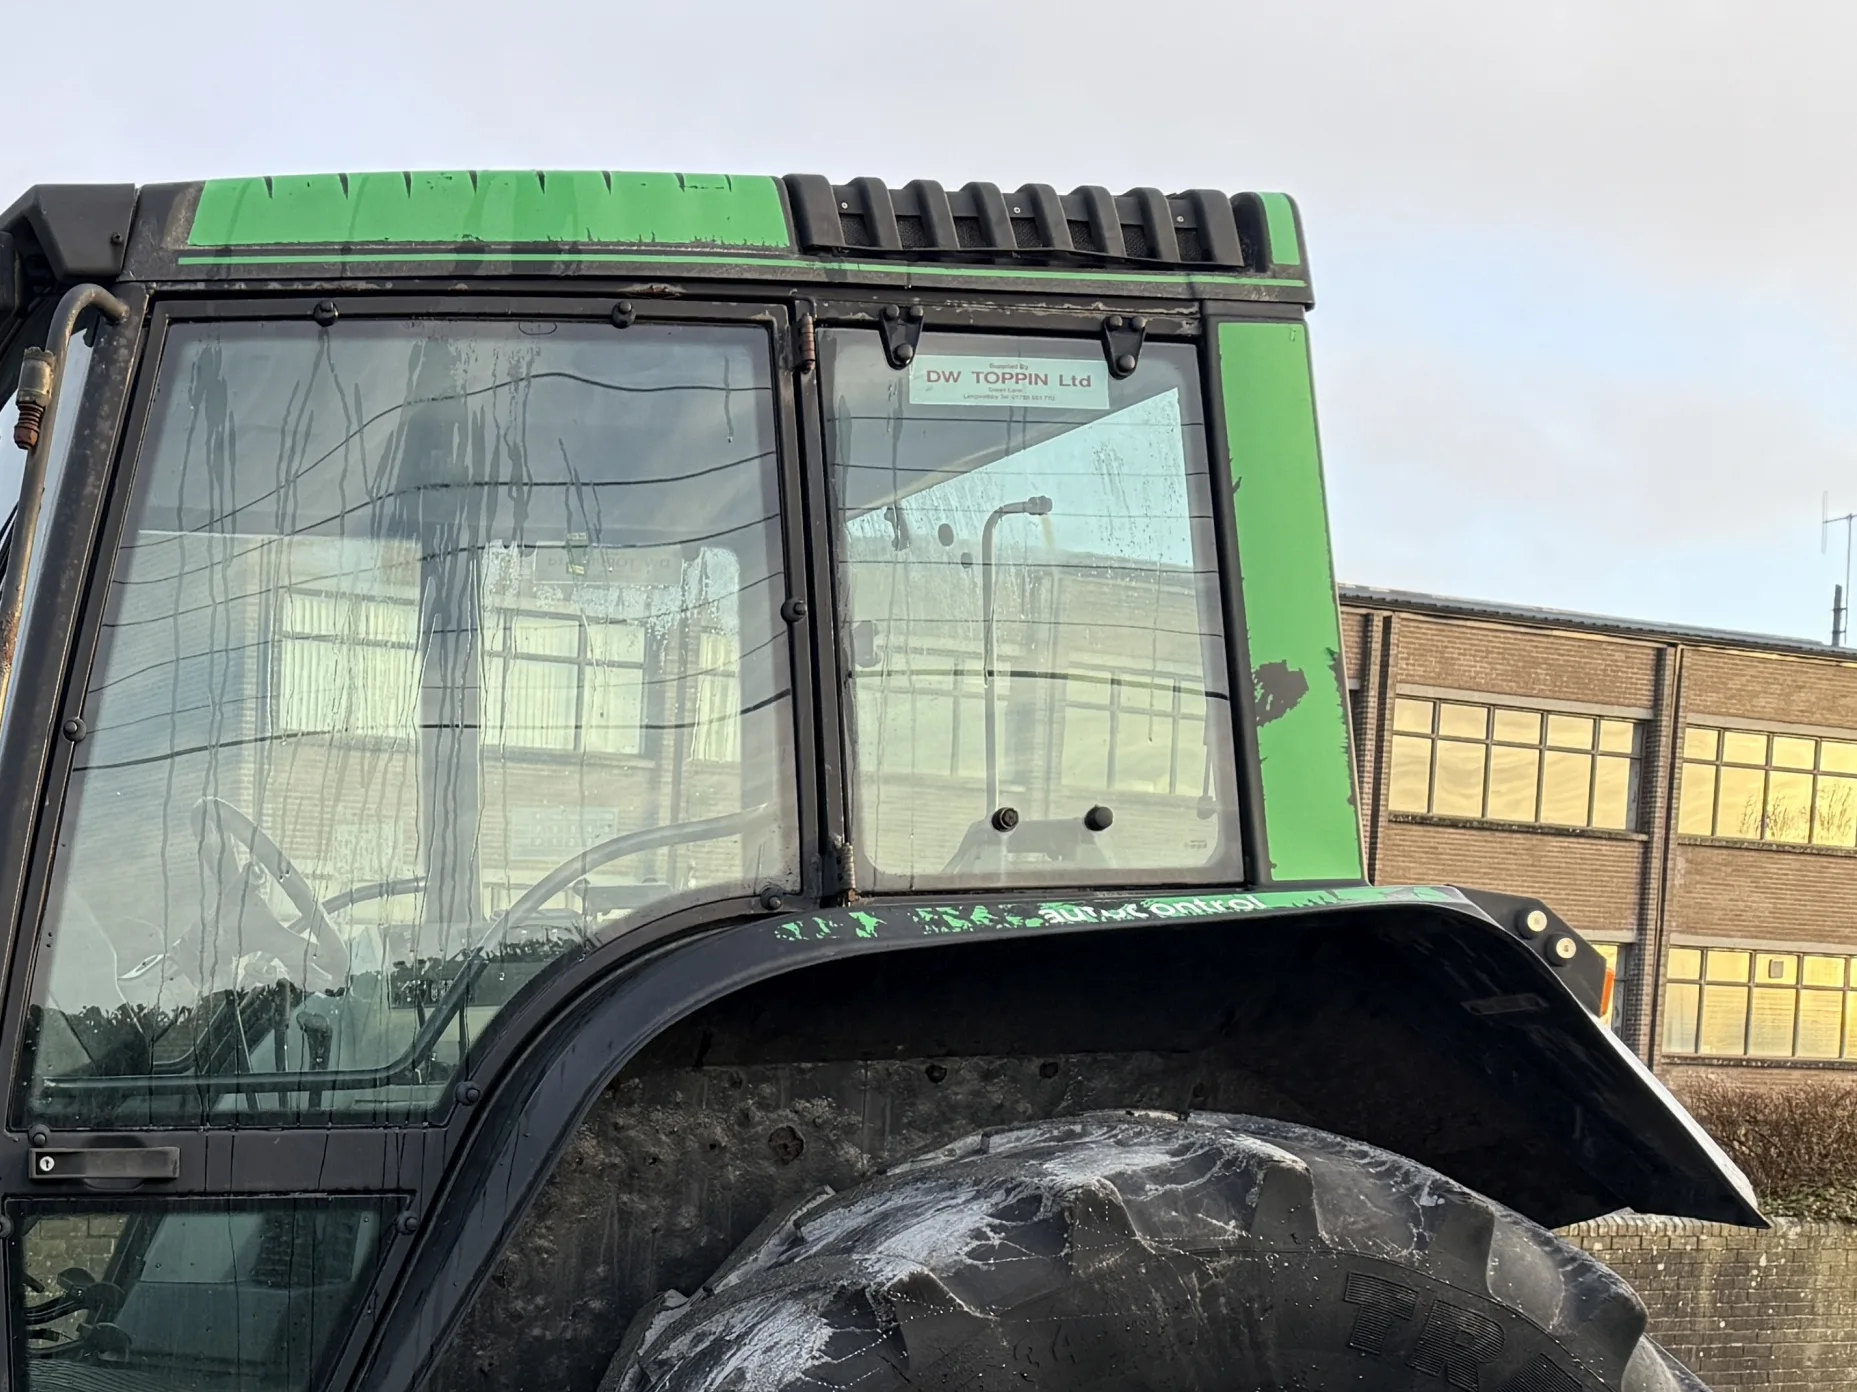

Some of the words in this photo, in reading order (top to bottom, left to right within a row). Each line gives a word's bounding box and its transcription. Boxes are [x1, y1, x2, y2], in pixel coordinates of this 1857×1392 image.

[926, 370, 962, 383] DW
[971, 371, 1049, 386] TOPPIN
[1059, 373, 1093, 388] Ltd
